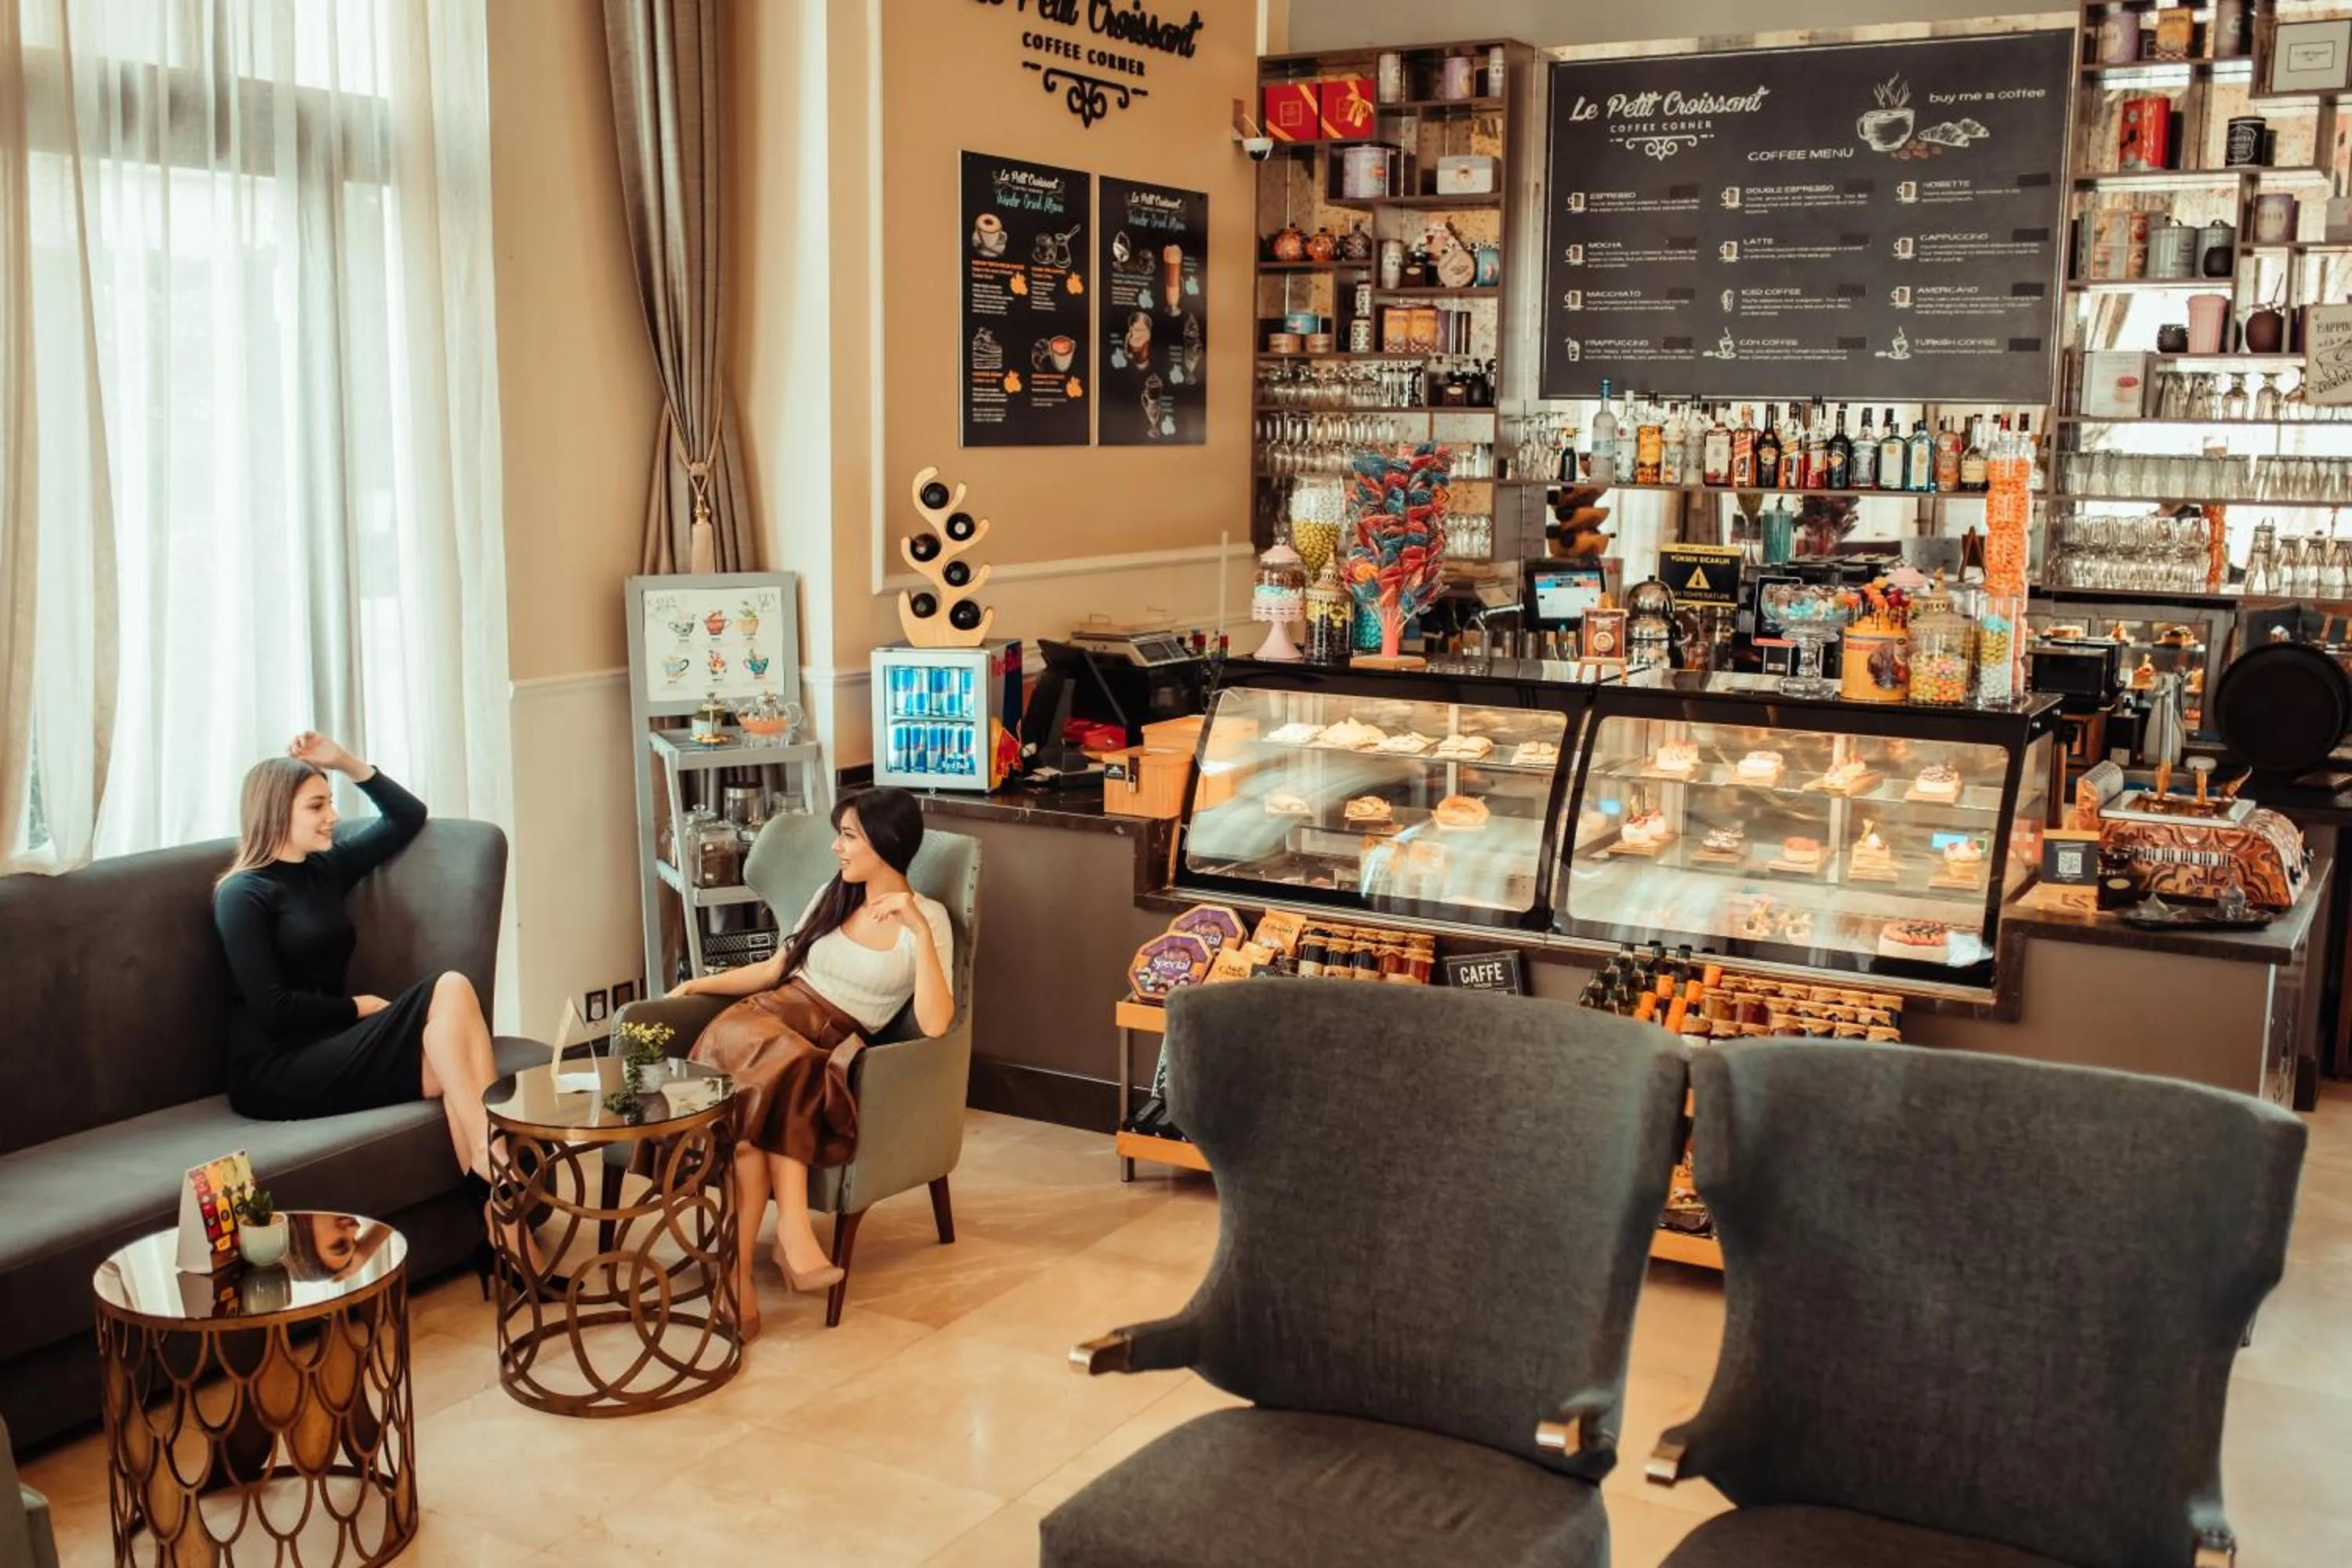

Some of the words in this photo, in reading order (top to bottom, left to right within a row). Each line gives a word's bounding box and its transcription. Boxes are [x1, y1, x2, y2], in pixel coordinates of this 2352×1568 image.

[1022, 31, 1081, 60] COFFEE
[1087, 49, 1145, 76] CORNER
[1569, 95, 1598, 122] Le
[1607, 90, 1663, 119] Petit
[1663, 85, 1771, 116] Croissant
[1929, 92, 1955, 105] buy
[1958, 91, 1982, 101] me
[1984, 90, 1994, 100] a
[1997, 87, 2046, 100] coffee
[1610, 123, 1656, 133] COFFEE
[1661, 119, 1713, 131] CORNER
[1748, 150, 1806, 162] COFFEE
[1809, 147, 1854, 159] MENU
